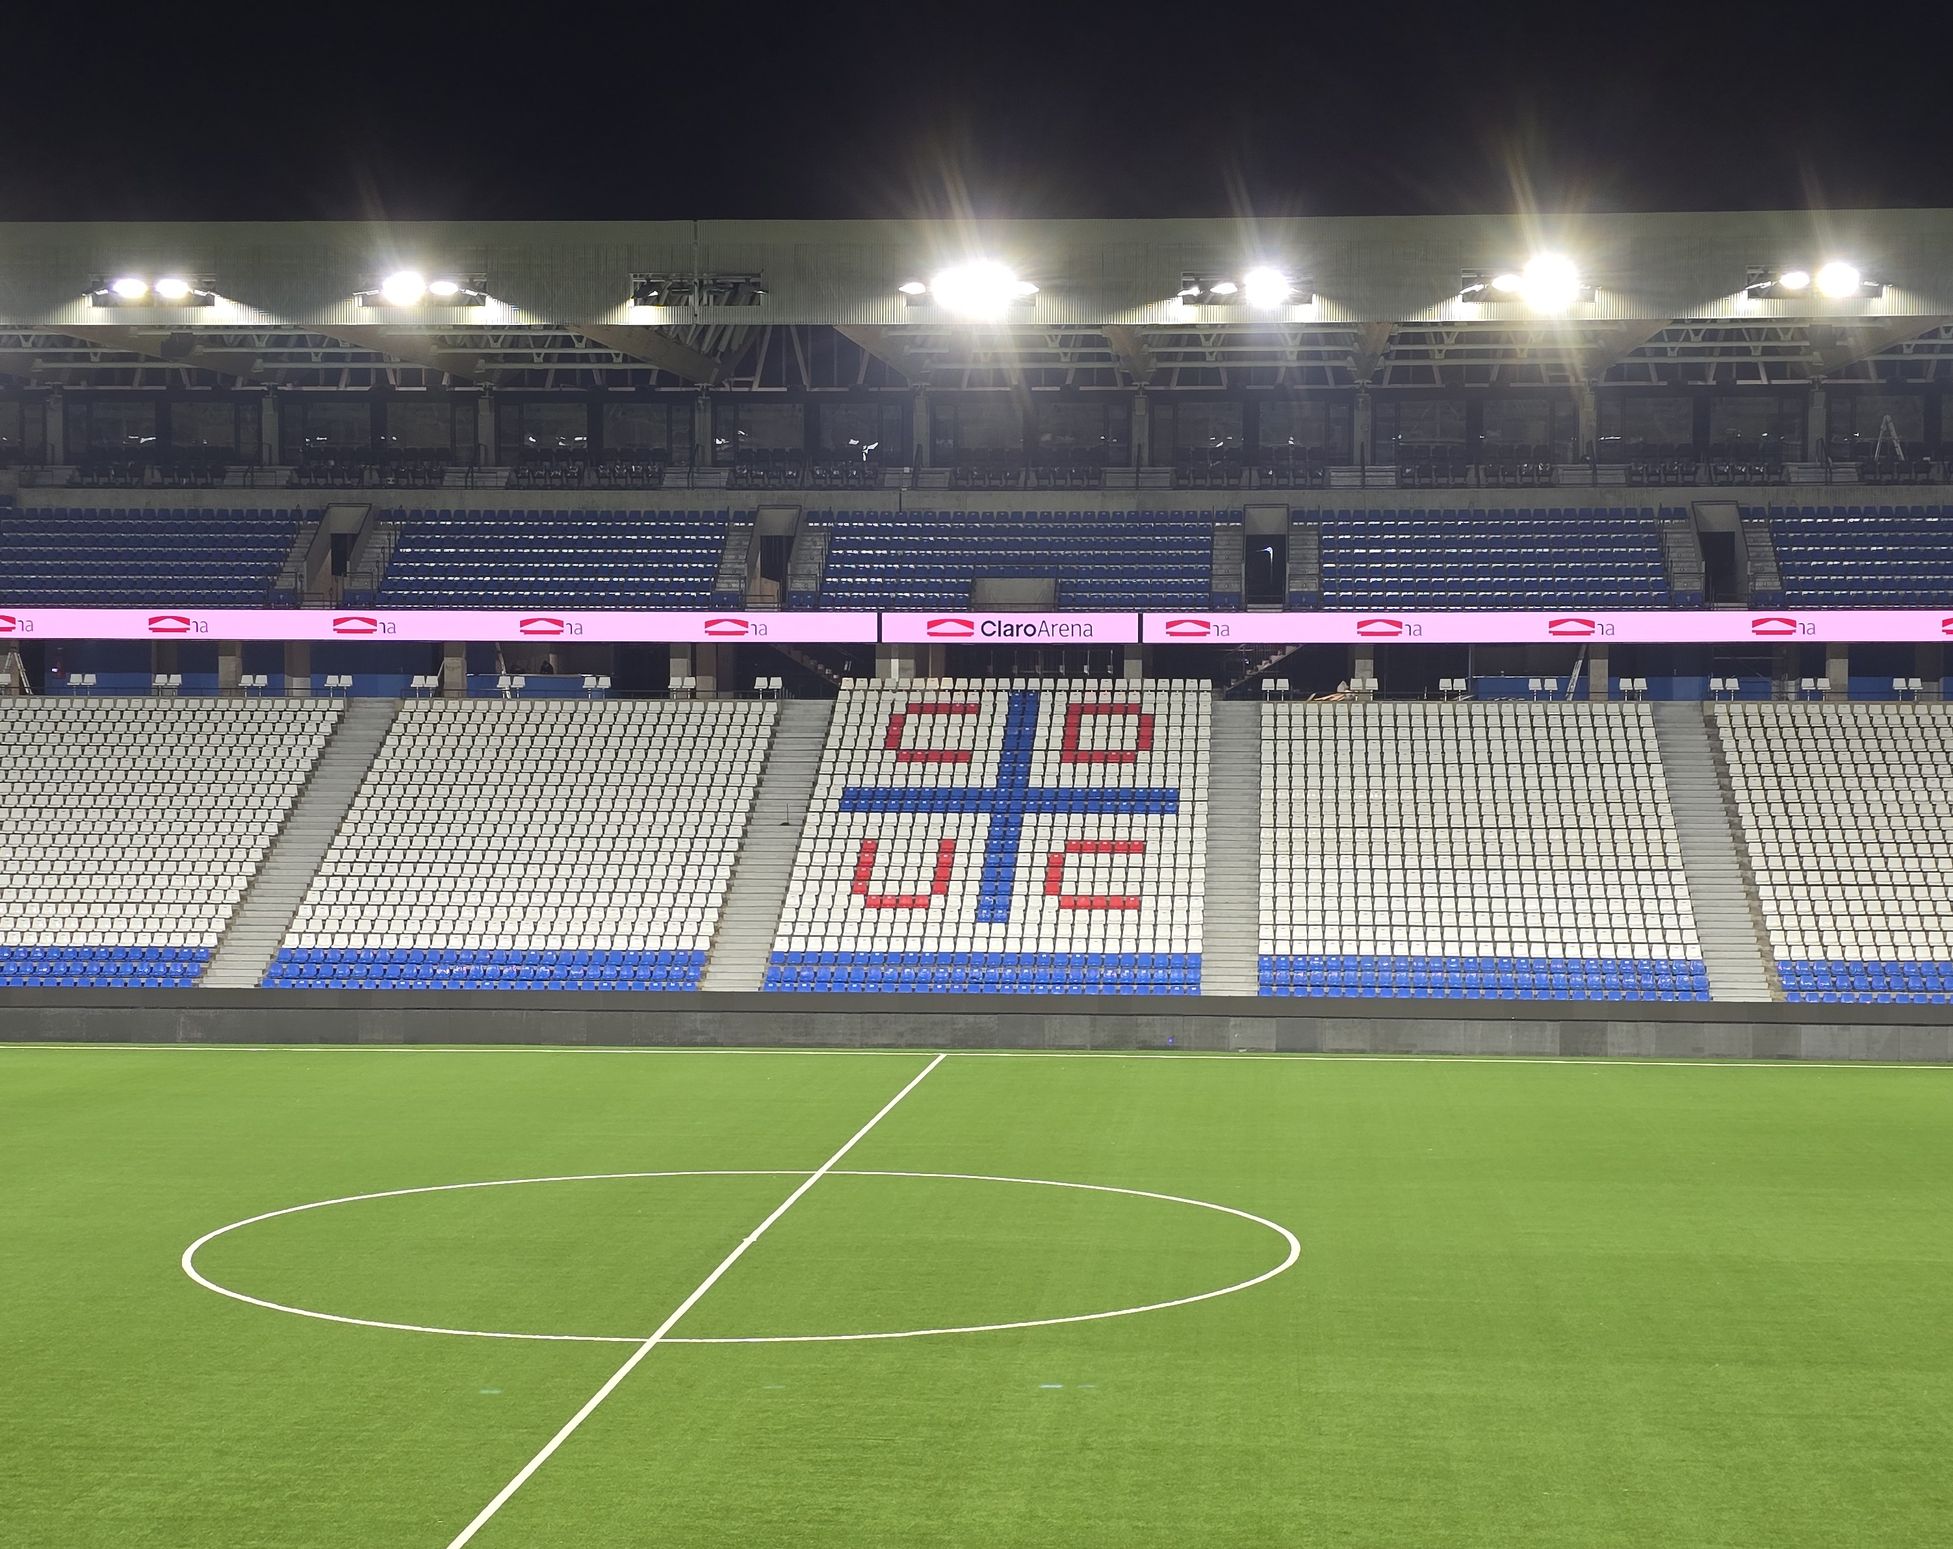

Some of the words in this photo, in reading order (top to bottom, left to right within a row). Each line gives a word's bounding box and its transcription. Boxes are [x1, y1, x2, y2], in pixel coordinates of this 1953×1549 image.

[981, 620, 1093, 637] ClaroArena
[885, 703, 980, 763] C
[852, 838, 956, 909] U
[1045, 840, 1145, 910] C
